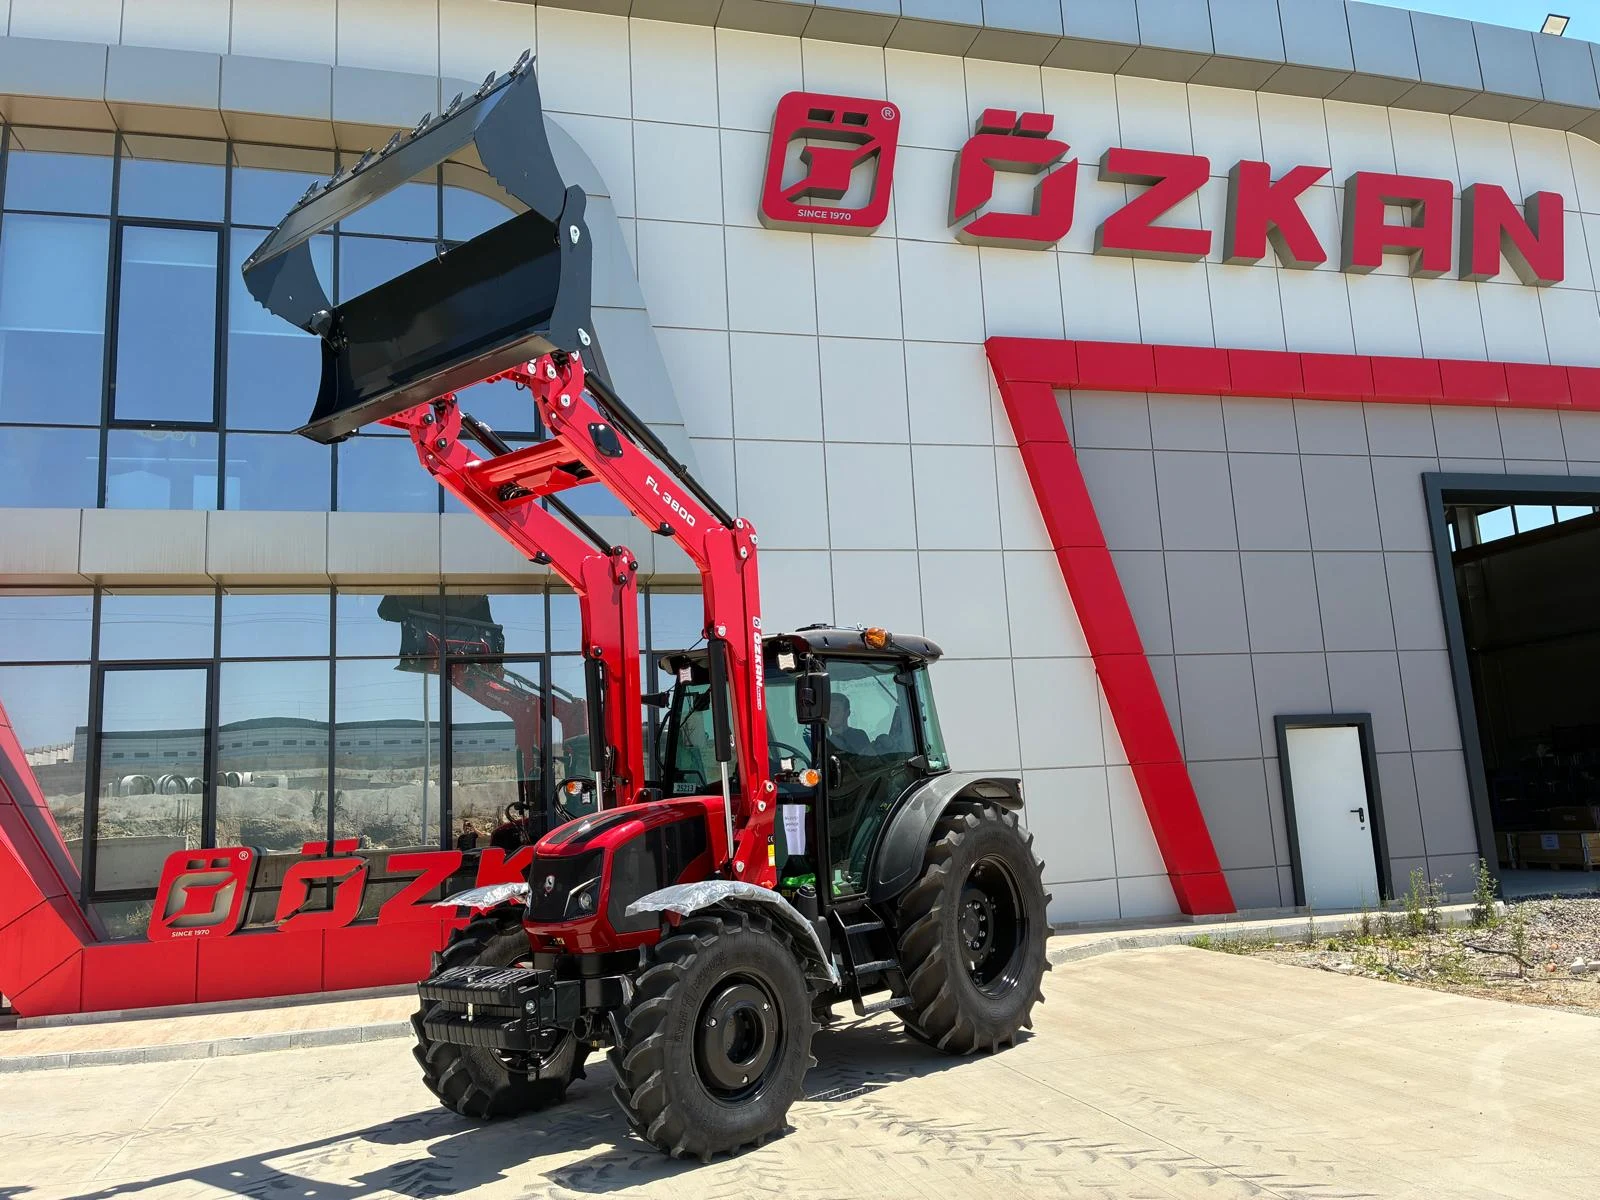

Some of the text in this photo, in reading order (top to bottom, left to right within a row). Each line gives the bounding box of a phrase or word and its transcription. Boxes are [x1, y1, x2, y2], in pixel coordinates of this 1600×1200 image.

[952, 108, 1564, 284] ÖZKAN
[797, 209, 852, 221] SINCE 1970
[645, 475, 696, 527] FL 3800
[171, 930, 193, 938] SINCE
